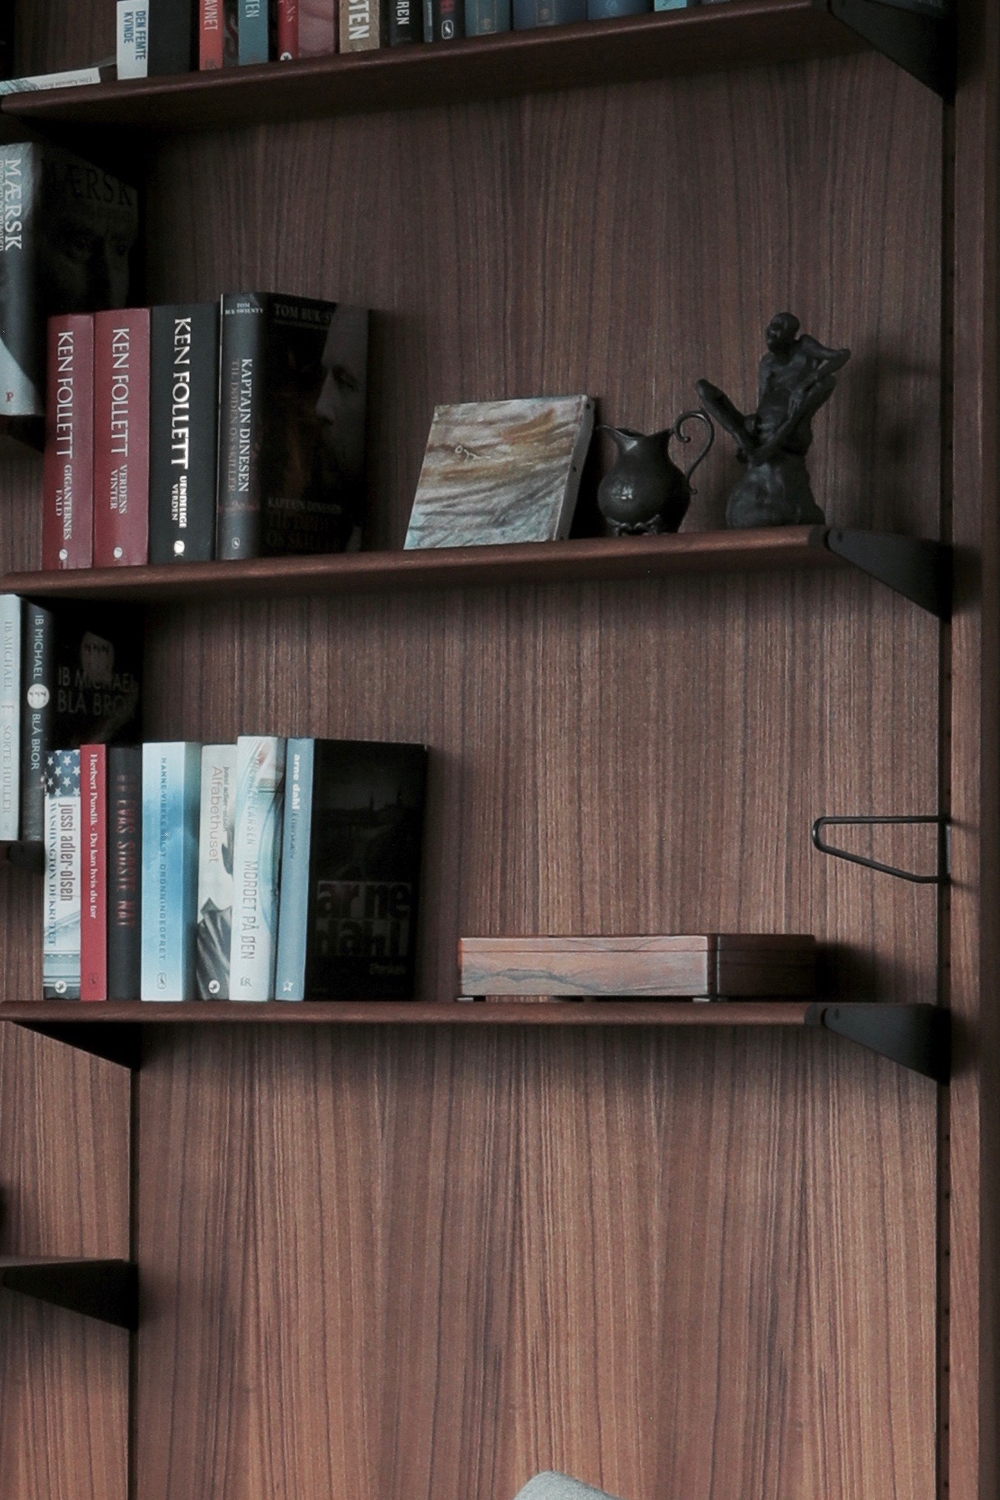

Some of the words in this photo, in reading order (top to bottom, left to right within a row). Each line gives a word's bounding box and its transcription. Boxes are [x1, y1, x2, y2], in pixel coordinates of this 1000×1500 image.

[123, 12, 134, 44] KVINDE
[135, 10, 146, 29] DEN
[135, 31, 147, 60] FEMTE
[3, 159, 22, 251] MÆRSK
[56, 330, 74, 372] KEN
[111, 328, 130, 369] KEN
[173, 317, 192, 365] KEN
[237, 358, 253, 424] KAPTAJN
[56, 378, 74, 460] FOLLETT
[111, 374, 130, 457] FOLLETT
[170, 370, 191, 470] FOLLETT
[238, 427, 252, 493] DINESEN
[55, 489, 64, 517] FALD
[63, 464, 73, 540] GIGANTERNES
[110, 469, 119, 510] VINTER
[118, 464, 128, 514] VERDENS
[171, 483, 180, 521] VERDEN
[34, 614, 43, 626] IB
[33, 628, 44, 680] MICHAEL
[2, 725, 12, 765] SORTE
[31, 713, 41, 737] BLÅ
[30, 738, 41, 770] BROR
[89, 753, 98, 790] Herbert
[293, 753, 301, 781] arne
[2, 766, 12, 814] HULLER
[89, 792, 98, 826] Pundik
[292, 783, 301, 811] dahl
[58, 803, 77, 832] jussi
[207, 765, 223, 864] Alfabethuset
[59, 836, 76, 902] adler-olsen
[89, 849, 98, 867] kan
[89, 868, 98, 888] hvis
[242, 860, 259, 911] MORDET
